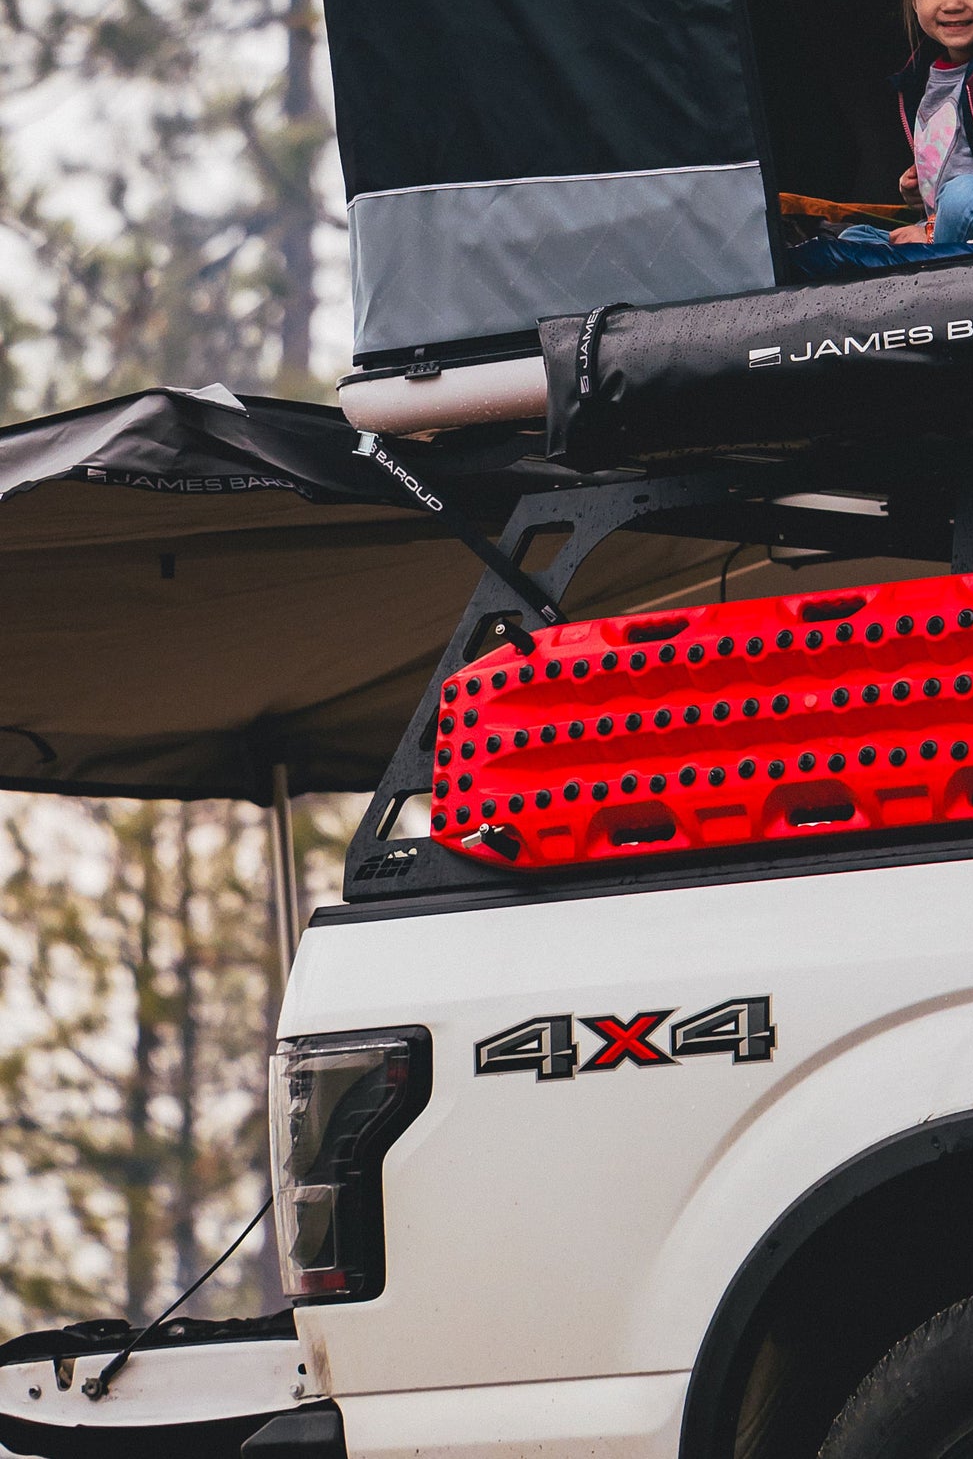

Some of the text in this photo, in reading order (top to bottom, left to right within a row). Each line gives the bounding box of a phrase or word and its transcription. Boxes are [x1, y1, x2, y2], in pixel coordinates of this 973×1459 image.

[790, 325, 934, 363] JAMES
[113, 473, 222, 491] JAMES
[375, 449, 443, 511] BAROUD
